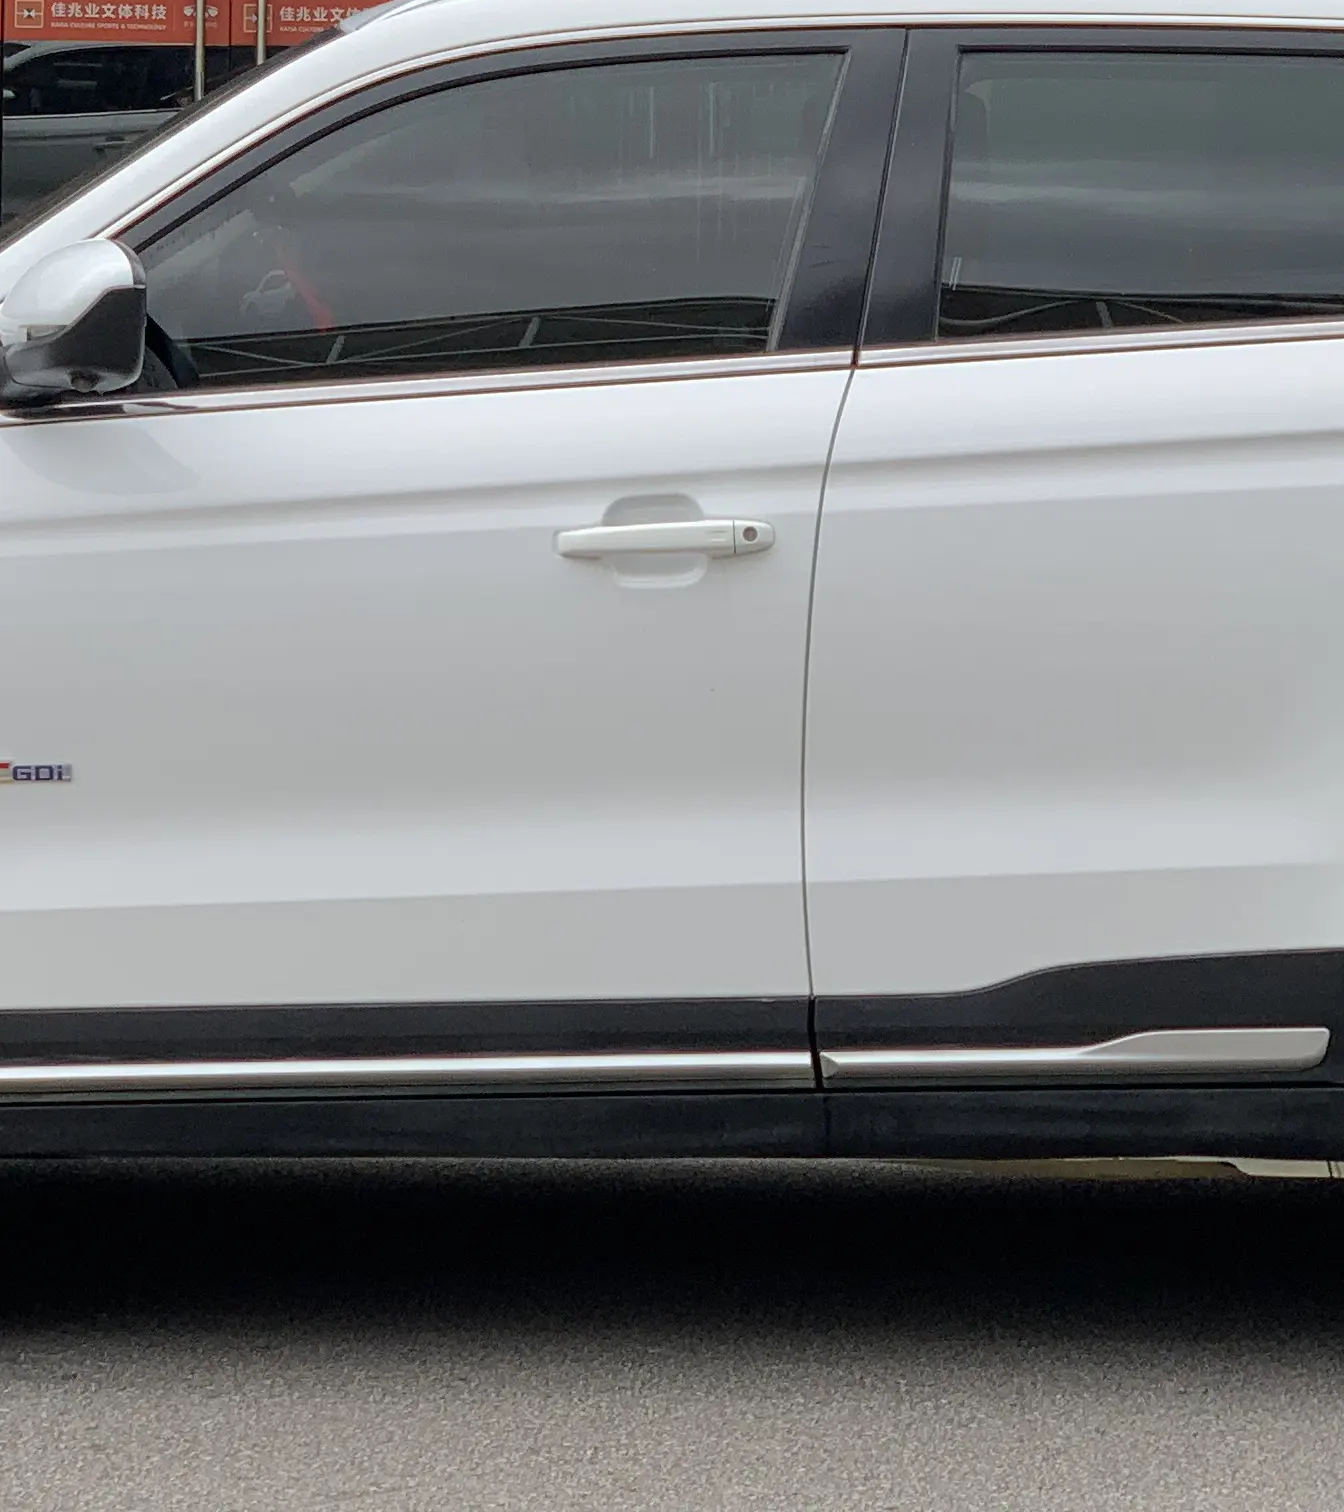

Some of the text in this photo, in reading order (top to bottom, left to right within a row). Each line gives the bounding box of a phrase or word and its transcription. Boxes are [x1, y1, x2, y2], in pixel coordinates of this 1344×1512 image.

[50, 2, 168, 20] 佳兆业文体科技
